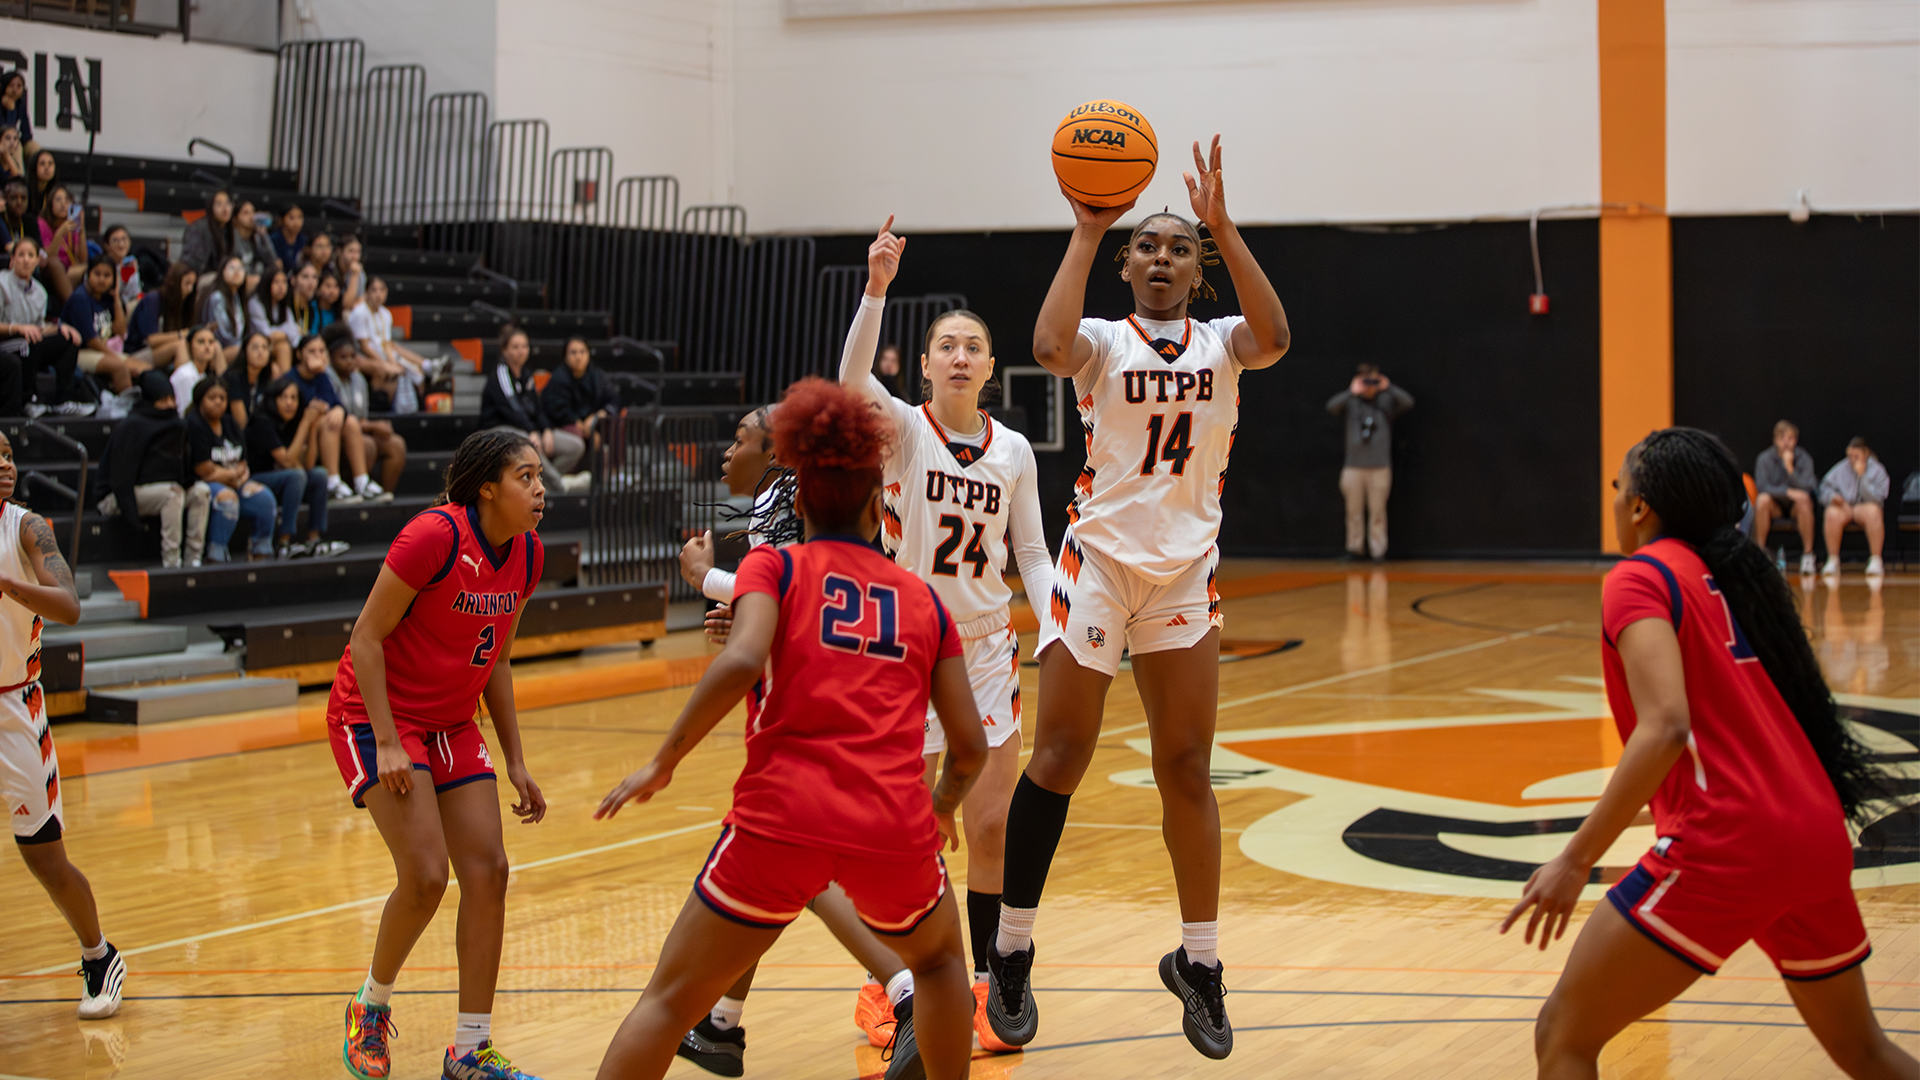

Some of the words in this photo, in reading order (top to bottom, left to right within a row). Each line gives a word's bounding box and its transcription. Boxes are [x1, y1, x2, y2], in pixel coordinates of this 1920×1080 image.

[0, 48, 102, 133] IN
[1069, 102, 1140, 126] Wilson
[1071, 128, 1126, 148] NCAA
[1122, 368, 1214, 404] UTPB
[1139, 411, 1196, 477] 14
[926, 469, 1002, 516] UTPB
[931, 513, 989, 579] 24
[819, 571, 908, 663] 21
[469, 623, 496, 668] 2
